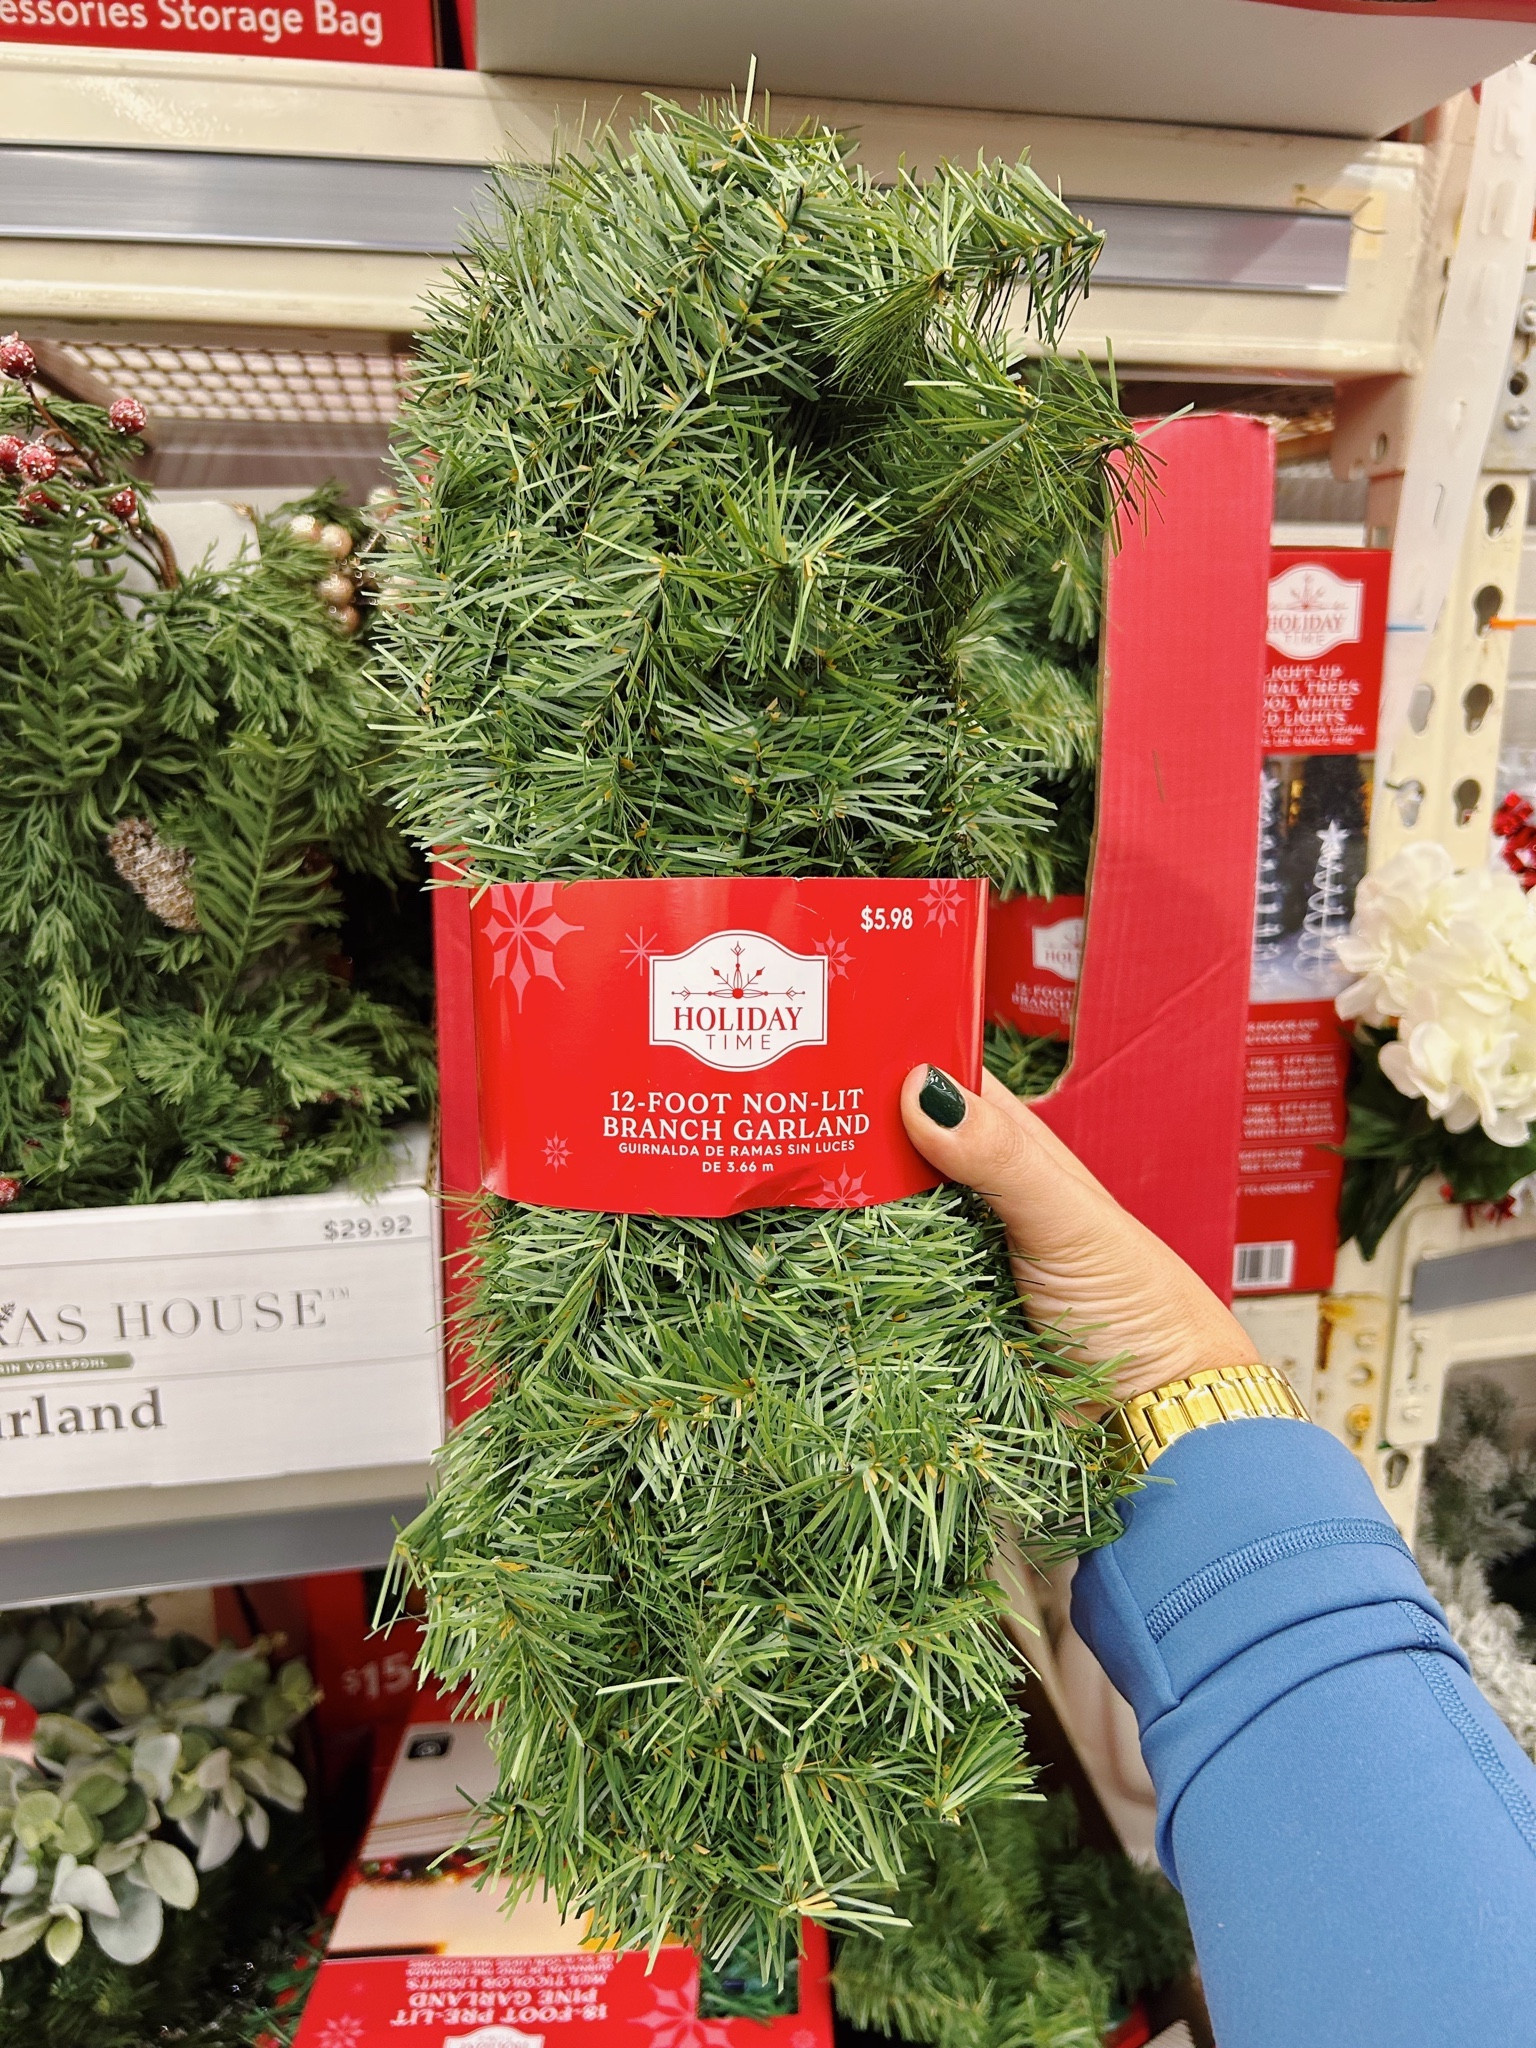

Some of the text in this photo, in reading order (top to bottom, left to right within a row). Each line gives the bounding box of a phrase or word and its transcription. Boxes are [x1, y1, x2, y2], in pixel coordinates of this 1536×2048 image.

[158, 0, 303, 43] Storage
[315, 0, 384, 47] Bag
[1265, 665, 1344, 680] IGHT-UP
[1296, 695, 1353, 711] WHITE
[1284, 710, 1347, 726] LIGHTS
[860, 904, 914, 933] $5.98
[1045, 950, 1080, 963] HOL
[1011, 992, 1071, 1010] BRANCH
[674, 1006, 803, 1031] HOLIDAY
[705, 1034, 771, 1050] TIME
[610, 1088, 864, 1114] 12-FOOT NON-LIT
[602, 1113, 870, 1141] BRANCH GARLAND
[618, 1140, 855, 1157] GUIRNALDA DE RAMAS SIN LUCES
[702, 1160, 774, 1173] DE 3.66 m
[323, 1214, 413, 1243] $29.92
[0, 1303, 88, 1346] AS
[26, 1357, 108, 1372] VOGELPOHL
[0, 1386, 166, 1440] rland
[406, 1976, 478, 1991] LIGHTS
[409, 1988, 598, 2008] PINE GARLAND
[390, 2003, 608, 2026] 18-FOOT PRE-LIT
